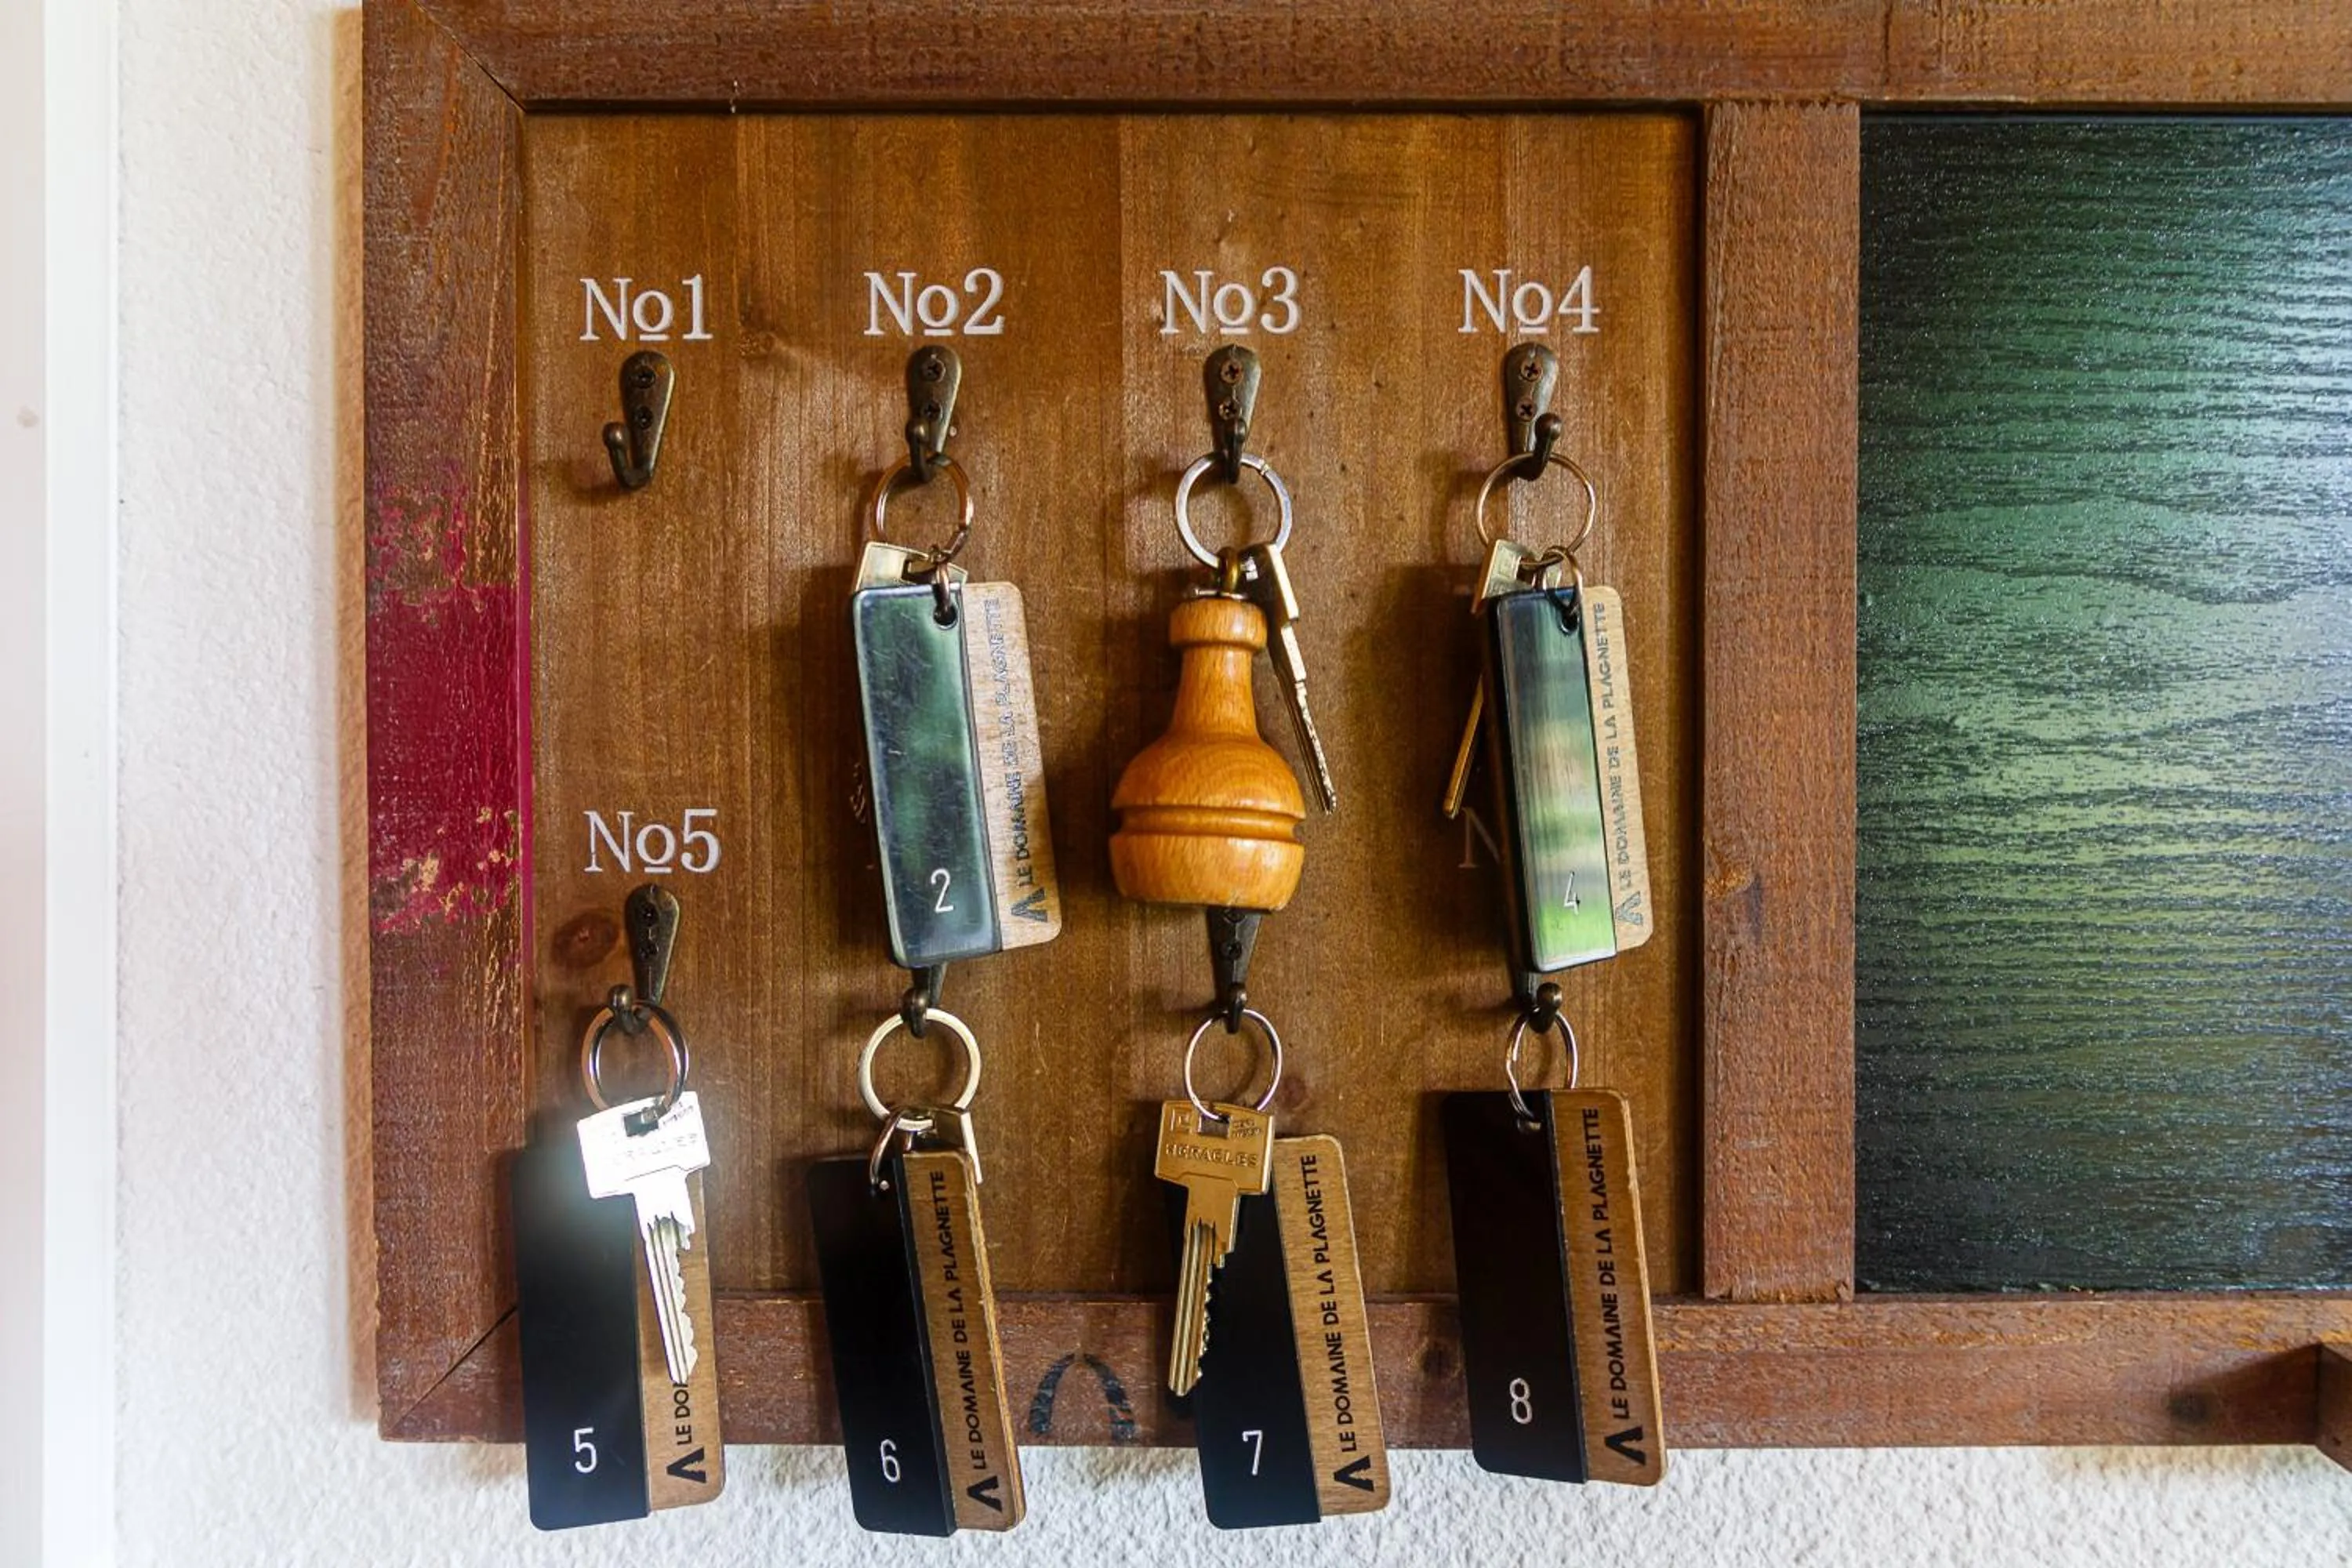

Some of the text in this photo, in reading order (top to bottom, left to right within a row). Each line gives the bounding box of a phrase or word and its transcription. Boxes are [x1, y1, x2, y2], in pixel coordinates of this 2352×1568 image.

[579, 274, 713, 341] No1
[863, 267, 1004, 336] No2
[1160, 267, 1301, 335] No3
[1457, 266, 1601, 334] No4
[583, 808, 721, 873] No5
[931, 868, 953, 913] 2
[1564, 871, 1581, 915] 4
[1582, 1108, 1629, 1419] LE DOMAINE DE LA PLAGNETTE
[931, 1171, 986, 1469] LE DOMAINE DE LA PLAGNETTE
[1301, 1155, 1356, 1452] LE DOMAINE DE LA PLAGNETTE
[1509, 1377, 1533, 1424] 8
[573, 1427, 597, 1474] 5
[676, 1425, 692, 1445] LE
[880, 1439, 901, 1483] 6
[1243, 1429, 1264, 1475] 7
